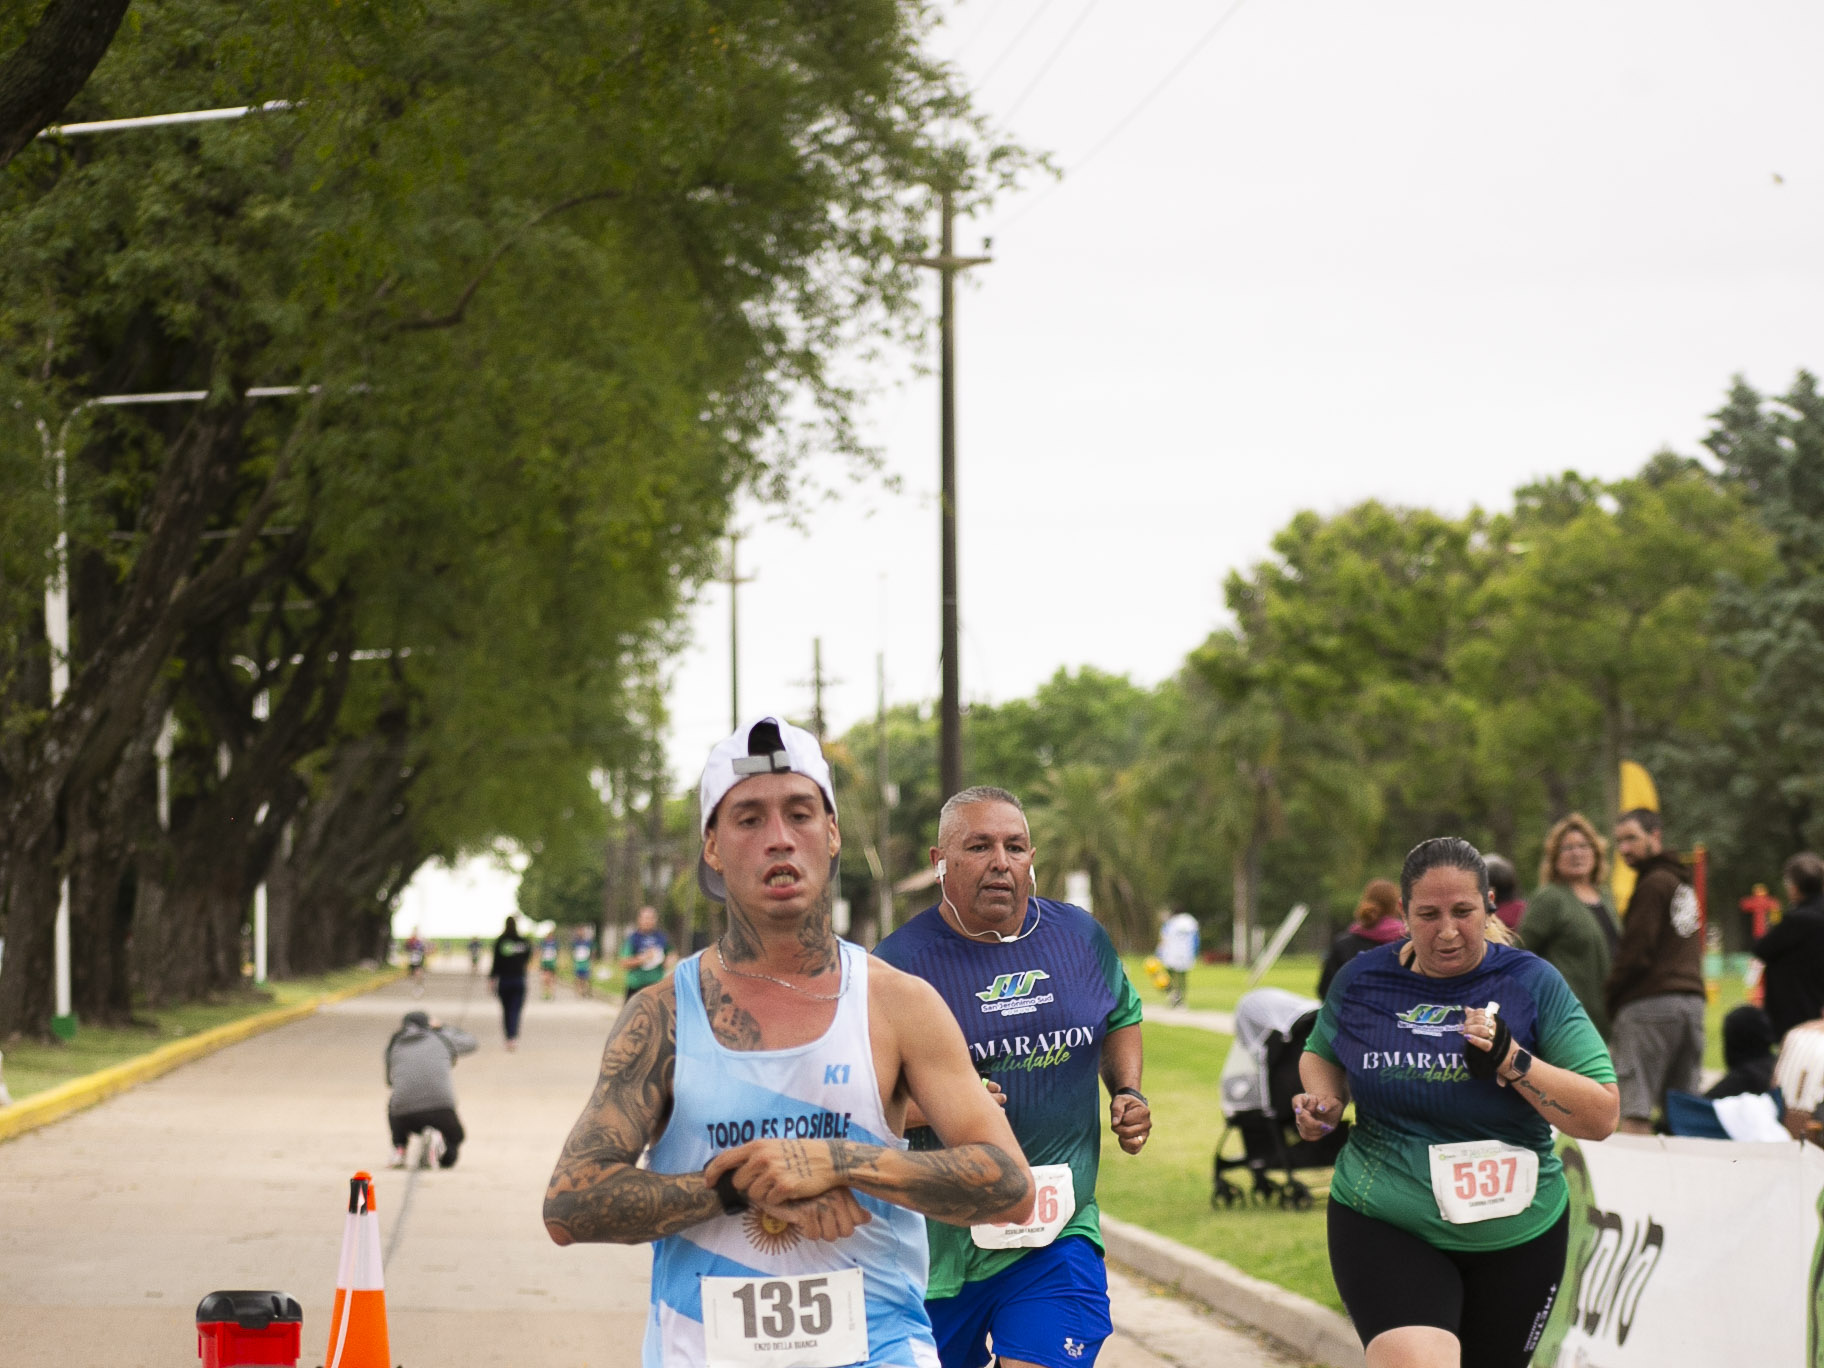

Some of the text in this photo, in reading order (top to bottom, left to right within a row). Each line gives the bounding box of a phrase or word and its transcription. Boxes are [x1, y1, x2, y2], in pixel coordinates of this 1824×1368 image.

[1037, 994, 1053, 1003] Sud
[987, 1043, 1071, 1072] aludable
[823, 1064, 851, 1085] K1
[706, 1112, 852, 1150] TODO ES POSIBLE
[1453, 1157, 1517, 1200] 537
[732, 1278, 833, 1339] 135
